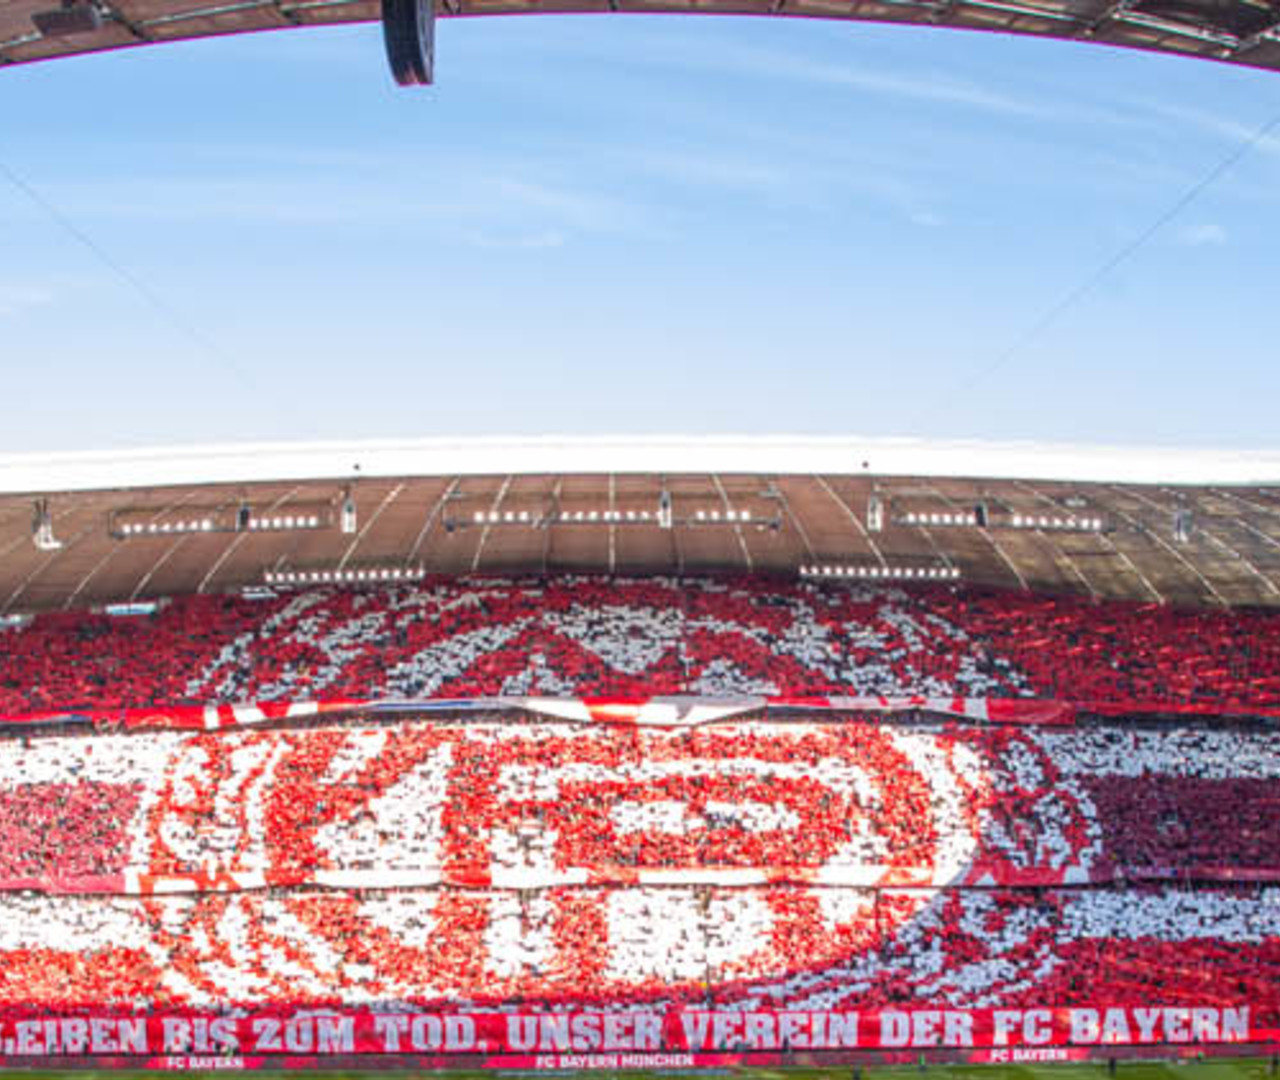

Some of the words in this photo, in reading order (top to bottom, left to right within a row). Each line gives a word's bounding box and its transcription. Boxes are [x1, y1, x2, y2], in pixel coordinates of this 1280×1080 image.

[163, 1017, 238, 1052] BIS
[253, 1016, 356, 1052] ZUM
[506, 1012, 665, 1051] UNSER
[680, 1010, 860, 1050] VEREIN
[879, 1009, 973, 1047] DER
[992, 1008, 1053, 1046] FC
[1071, 1005, 1251, 1044] BAYERN
[535, 1055, 556, 1069] FC
[559, 1055, 617, 1069] BAYERN
